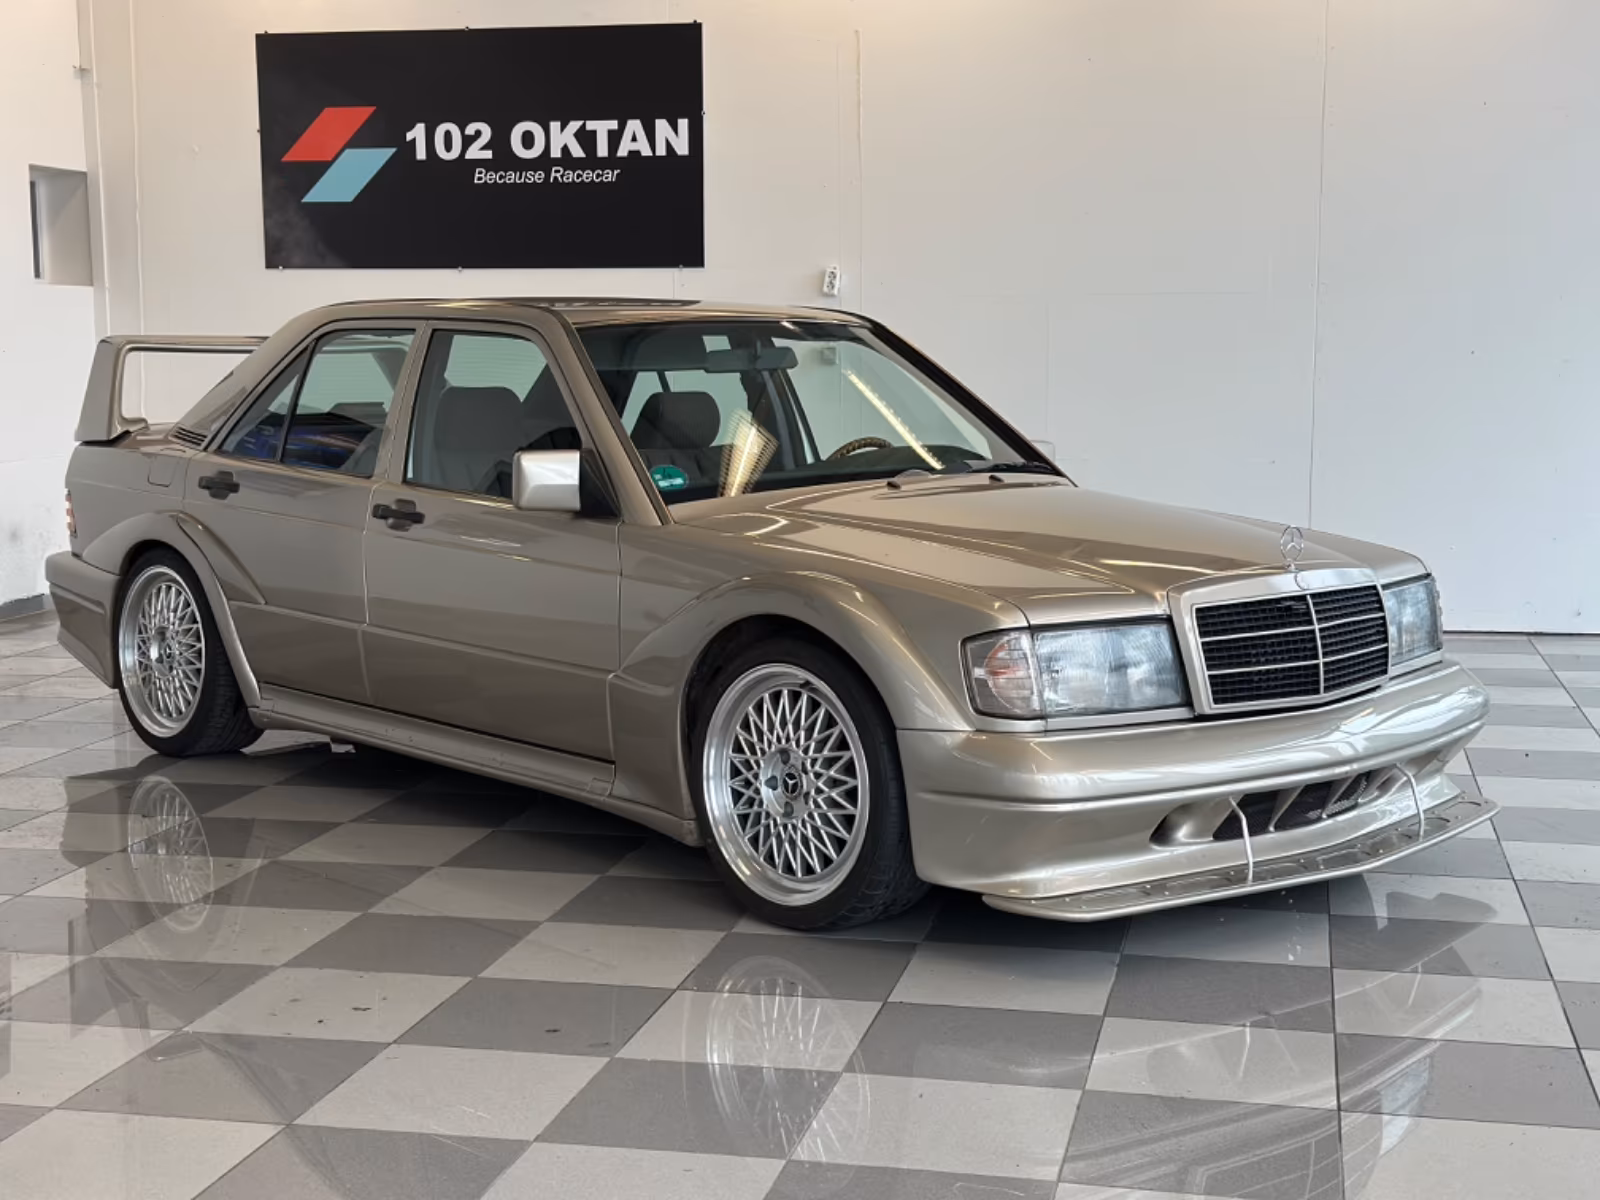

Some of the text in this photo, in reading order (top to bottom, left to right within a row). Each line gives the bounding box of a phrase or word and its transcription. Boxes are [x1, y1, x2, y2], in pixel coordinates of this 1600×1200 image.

[405, 117, 690, 161] 102 OKTAN
[473, 165, 621, 185] Because Racecar
